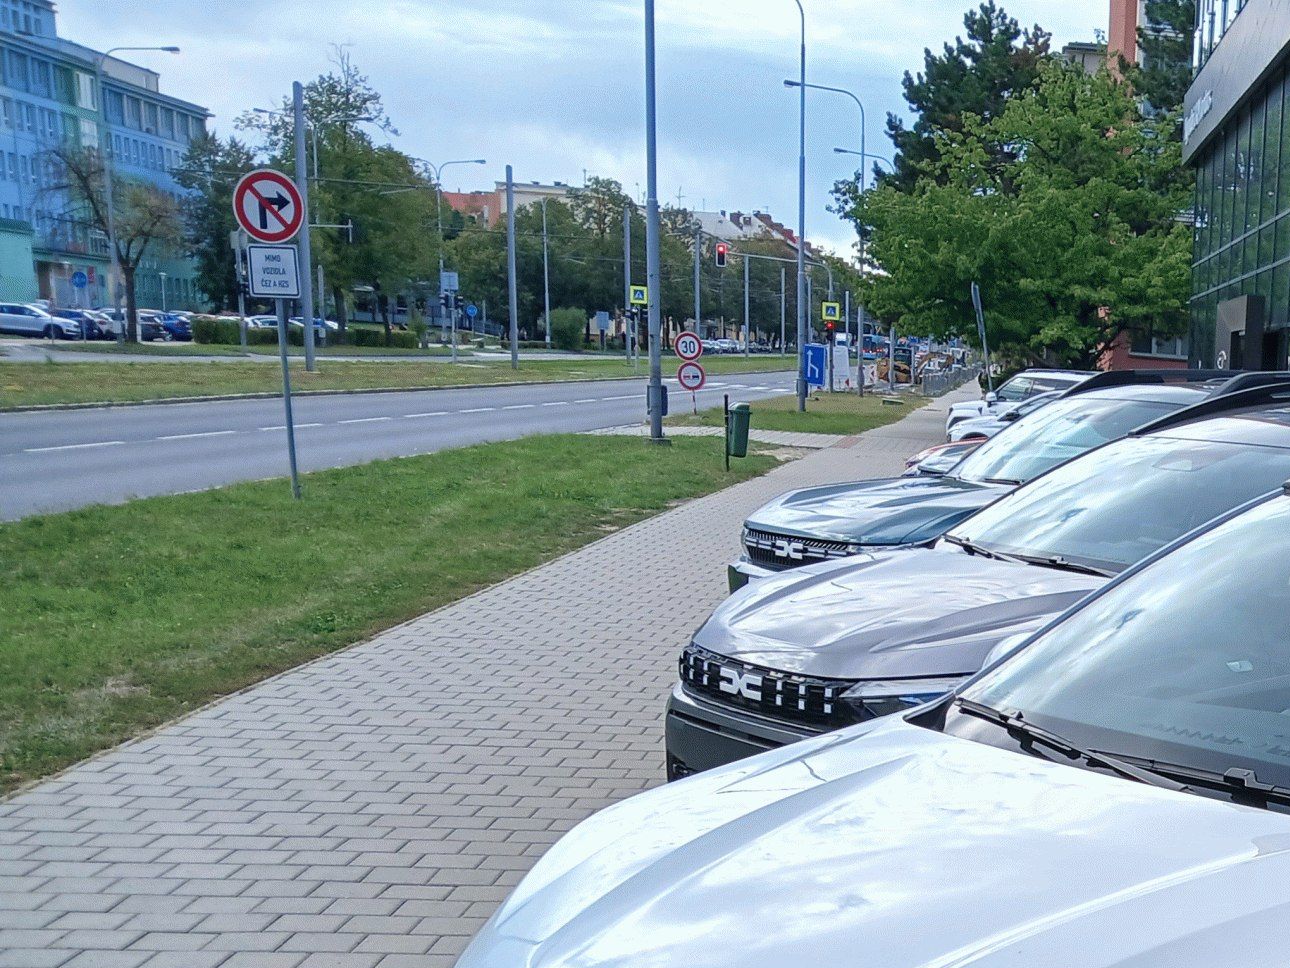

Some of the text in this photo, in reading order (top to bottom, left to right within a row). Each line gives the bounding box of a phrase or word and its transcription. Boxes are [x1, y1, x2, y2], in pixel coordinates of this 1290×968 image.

[264, 254, 281, 262] MIMO
[262, 267, 286, 275] VOZIDLA
[681, 340, 696, 354] 30
